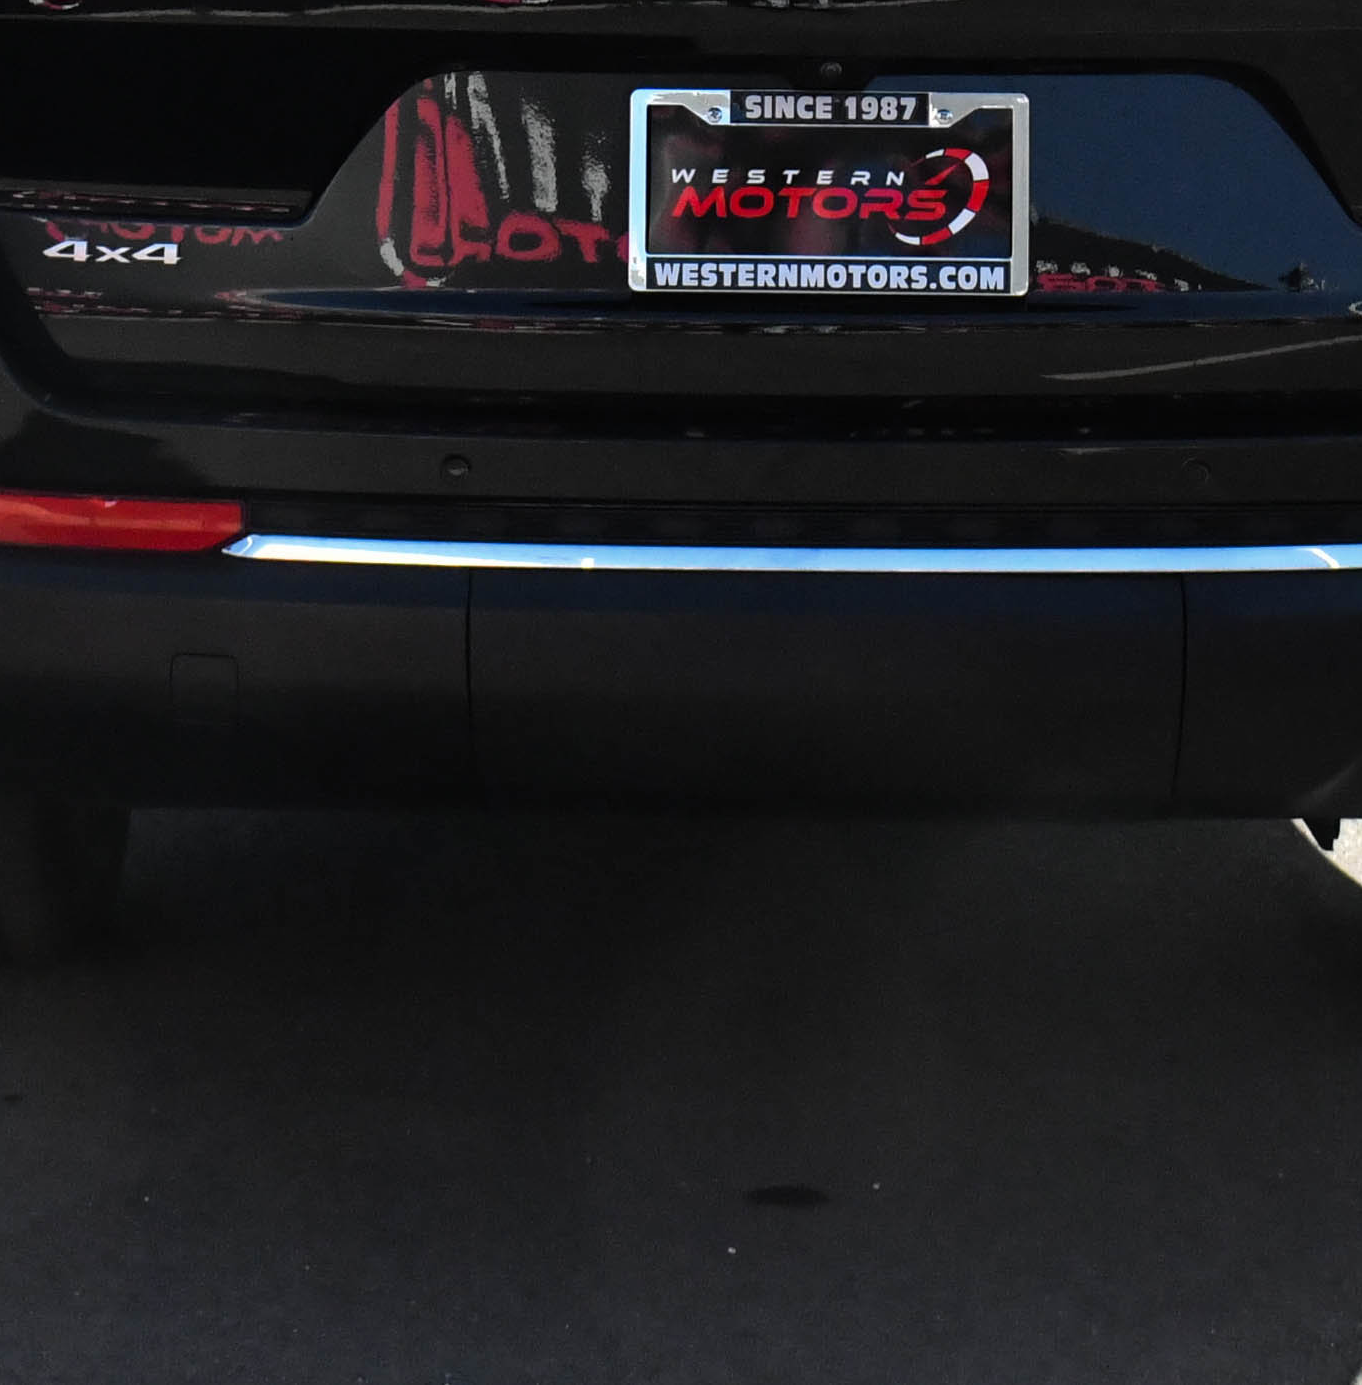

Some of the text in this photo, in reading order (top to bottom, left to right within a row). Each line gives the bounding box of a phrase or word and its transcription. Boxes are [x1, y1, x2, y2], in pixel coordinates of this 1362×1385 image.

[745, 95, 917, 121] SINCE 1987
[671, 167, 905, 186] WESTERN
[671, 186, 948, 221] MOTORS
[42, 239, 182, 267] 4x4
[654, 261, 1006, 291] WESTERNMOTORS.COM
